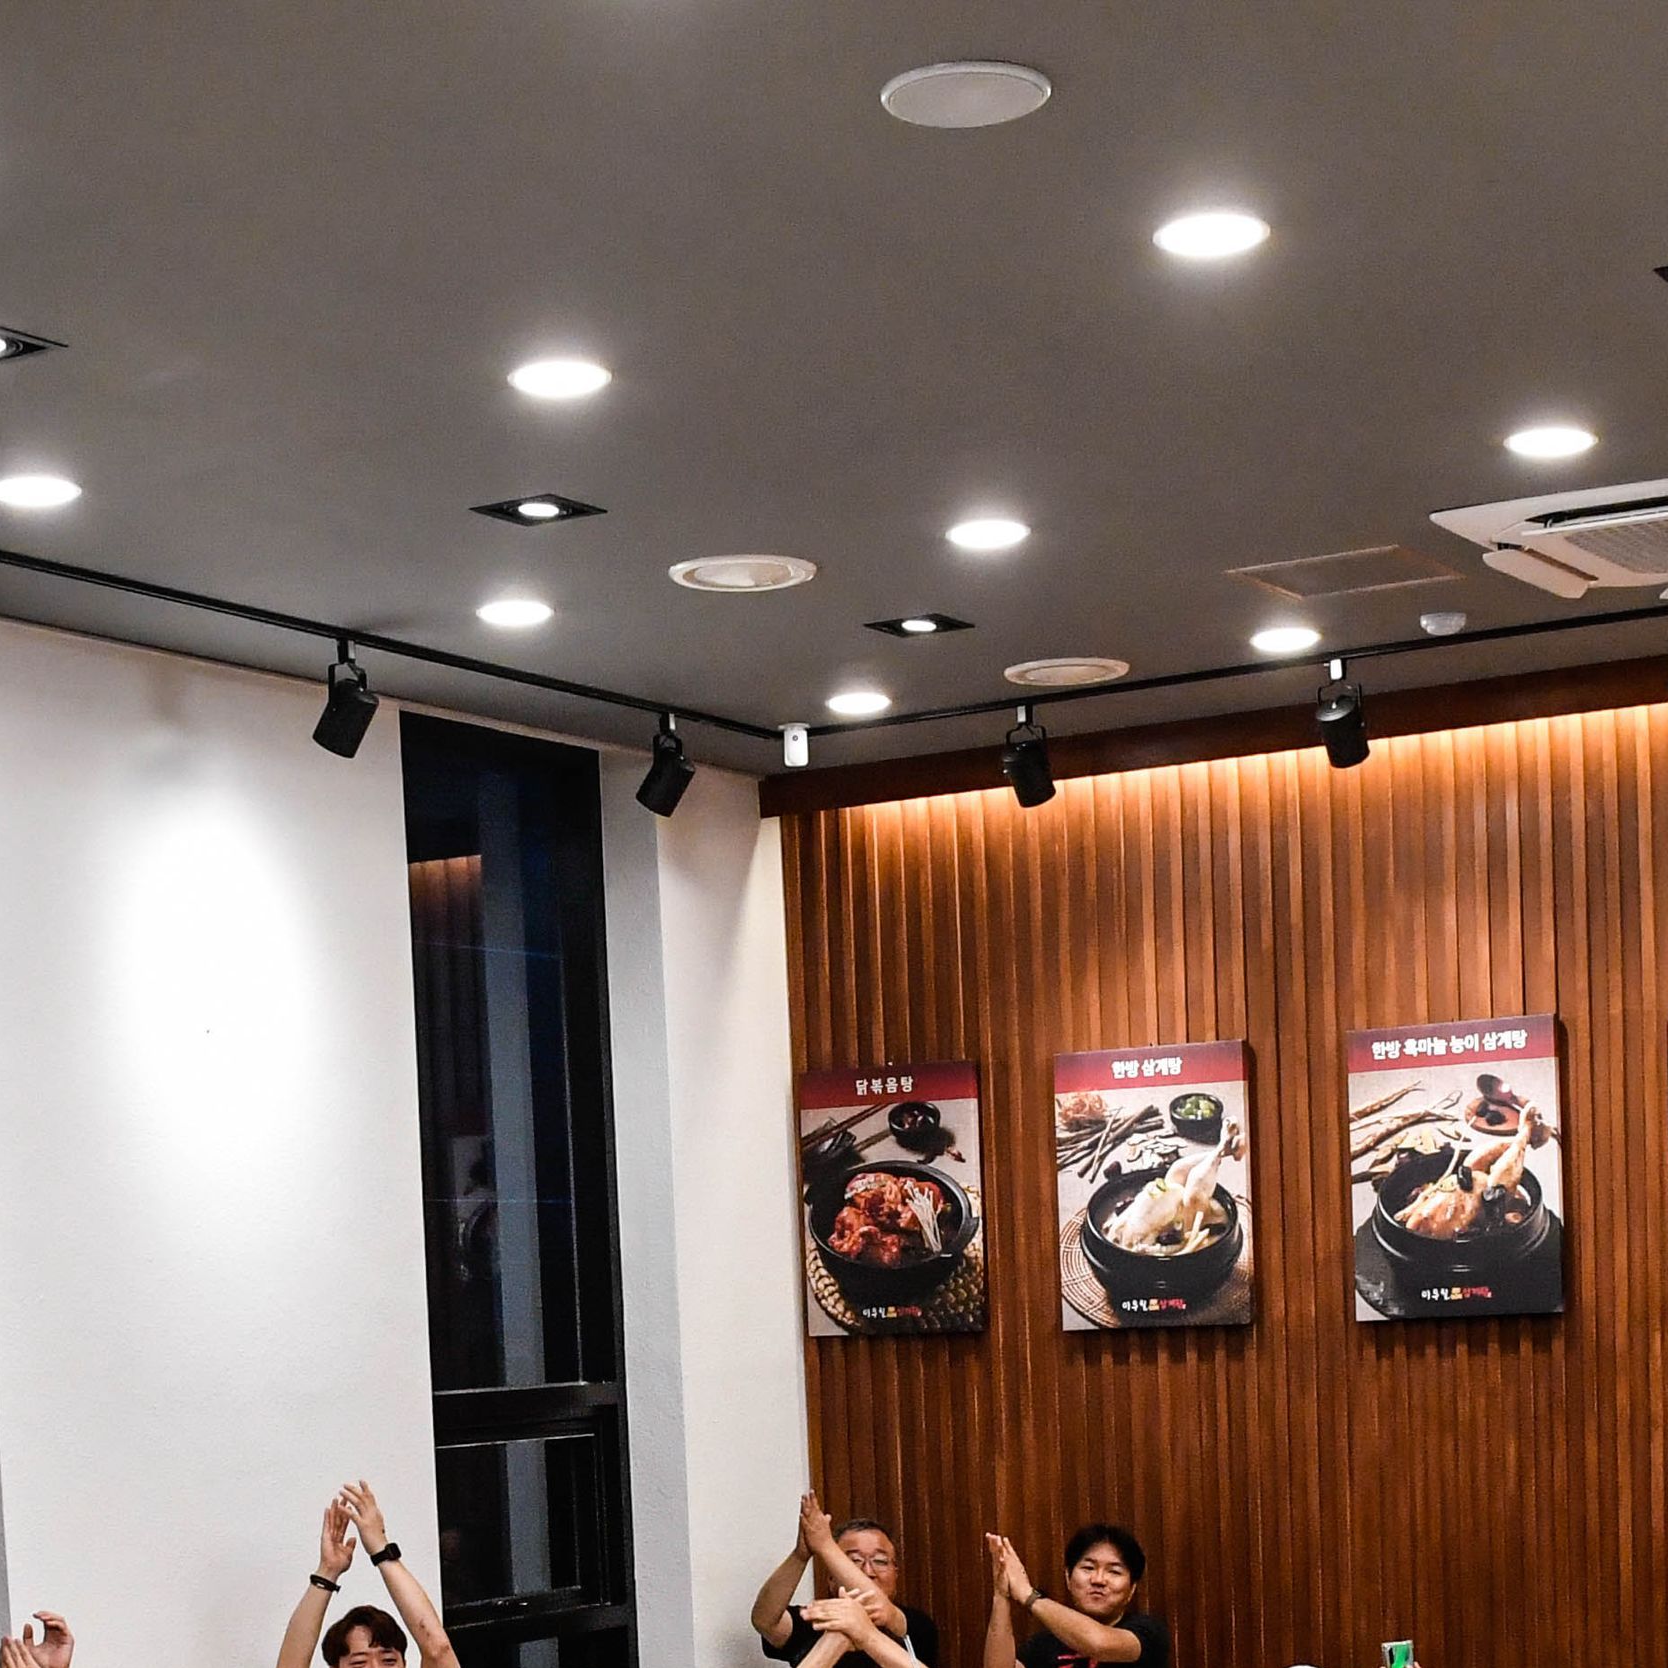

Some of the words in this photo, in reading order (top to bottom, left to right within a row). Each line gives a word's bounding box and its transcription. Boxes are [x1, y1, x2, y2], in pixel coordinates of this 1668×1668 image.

[1372, 1039, 1399, 1060] 한방
[1482, 1029, 1528, 1052] 삼계탕
[1111, 1059, 1138, 1080] 한방
[1141, 1057, 1182, 1078] 삼계탕
[856, 1075, 914, 1096] 닭볶음탕
